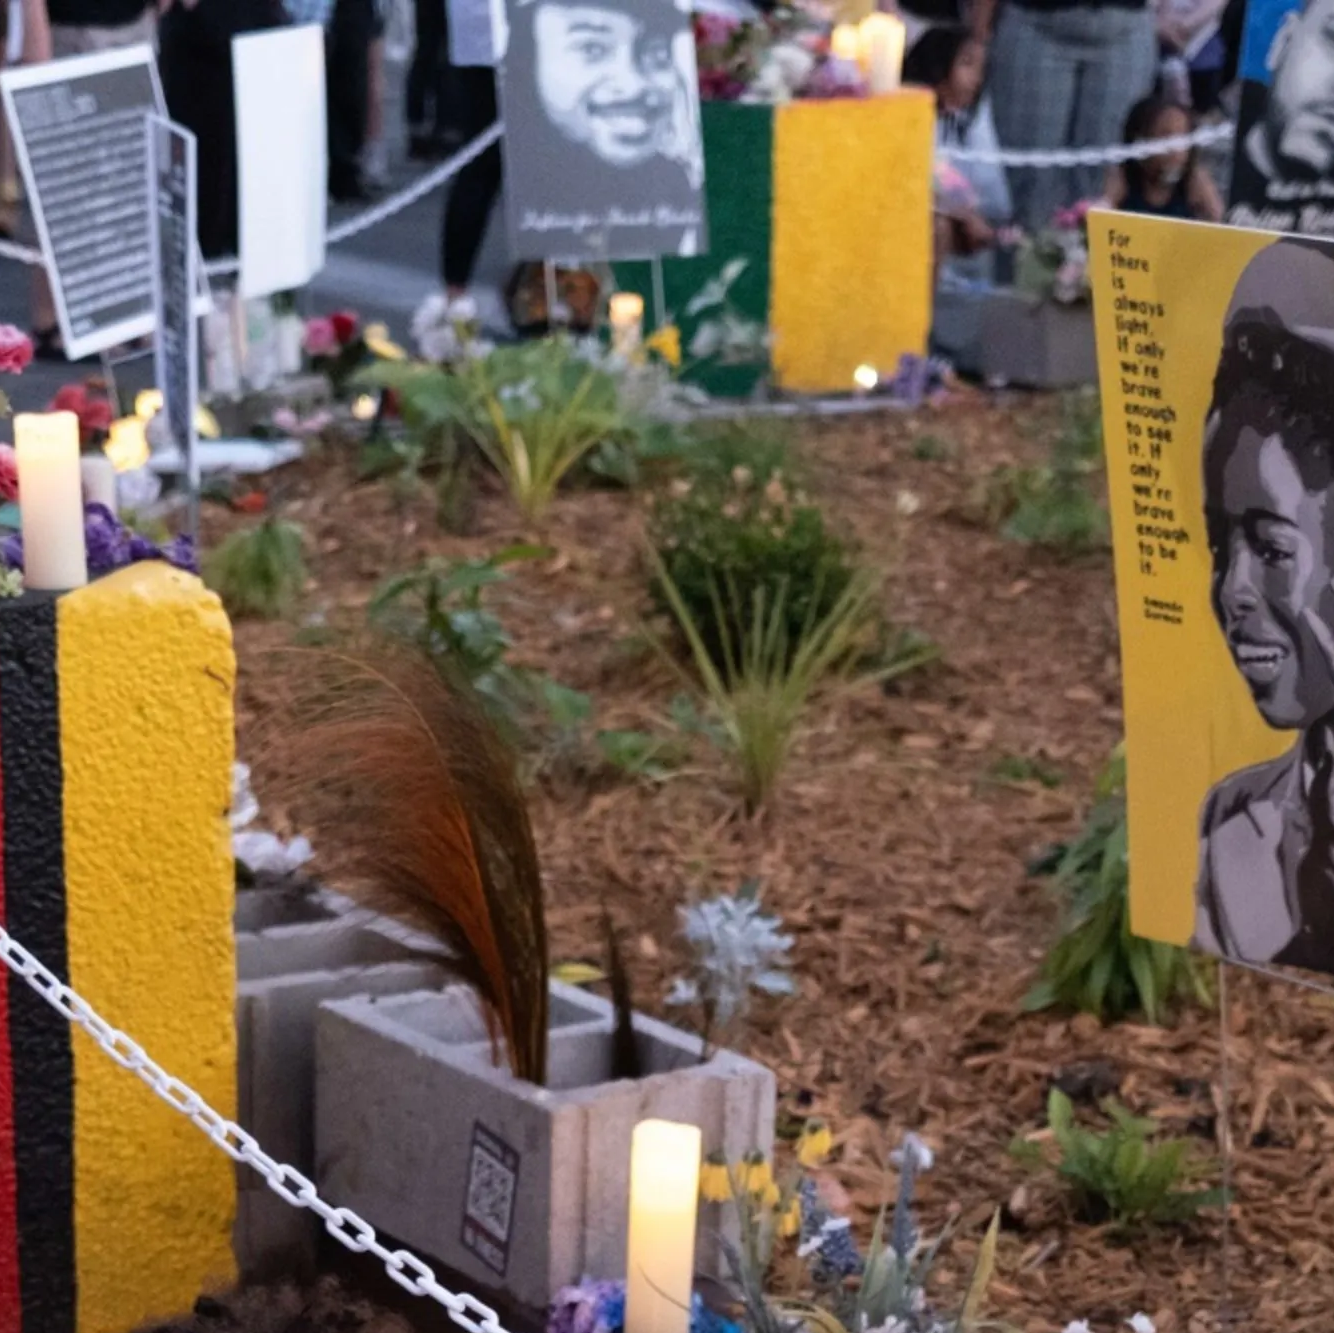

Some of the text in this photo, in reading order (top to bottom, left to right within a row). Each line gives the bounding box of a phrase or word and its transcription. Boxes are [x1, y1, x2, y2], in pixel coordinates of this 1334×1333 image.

[1108, 229, 1130, 248] For
[1110, 252, 1149, 272] there
[1110, 271, 1124, 290] is
[1114, 295, 1164, 318] always
[1135, 341, 1165, 360] only
[1120, 360, 1159, 379] we're
[1121, 378, 1161, 400] brave
[1124, 401, 1176, 424] enough
[1126, 421, 1172, 443] to see
[1130, 462, 1160, 481] only
[1133, 499, 1174, 521] brave
[1136, 523, 1189, 544] enough
[1138, 541, 1177, 560] to be
